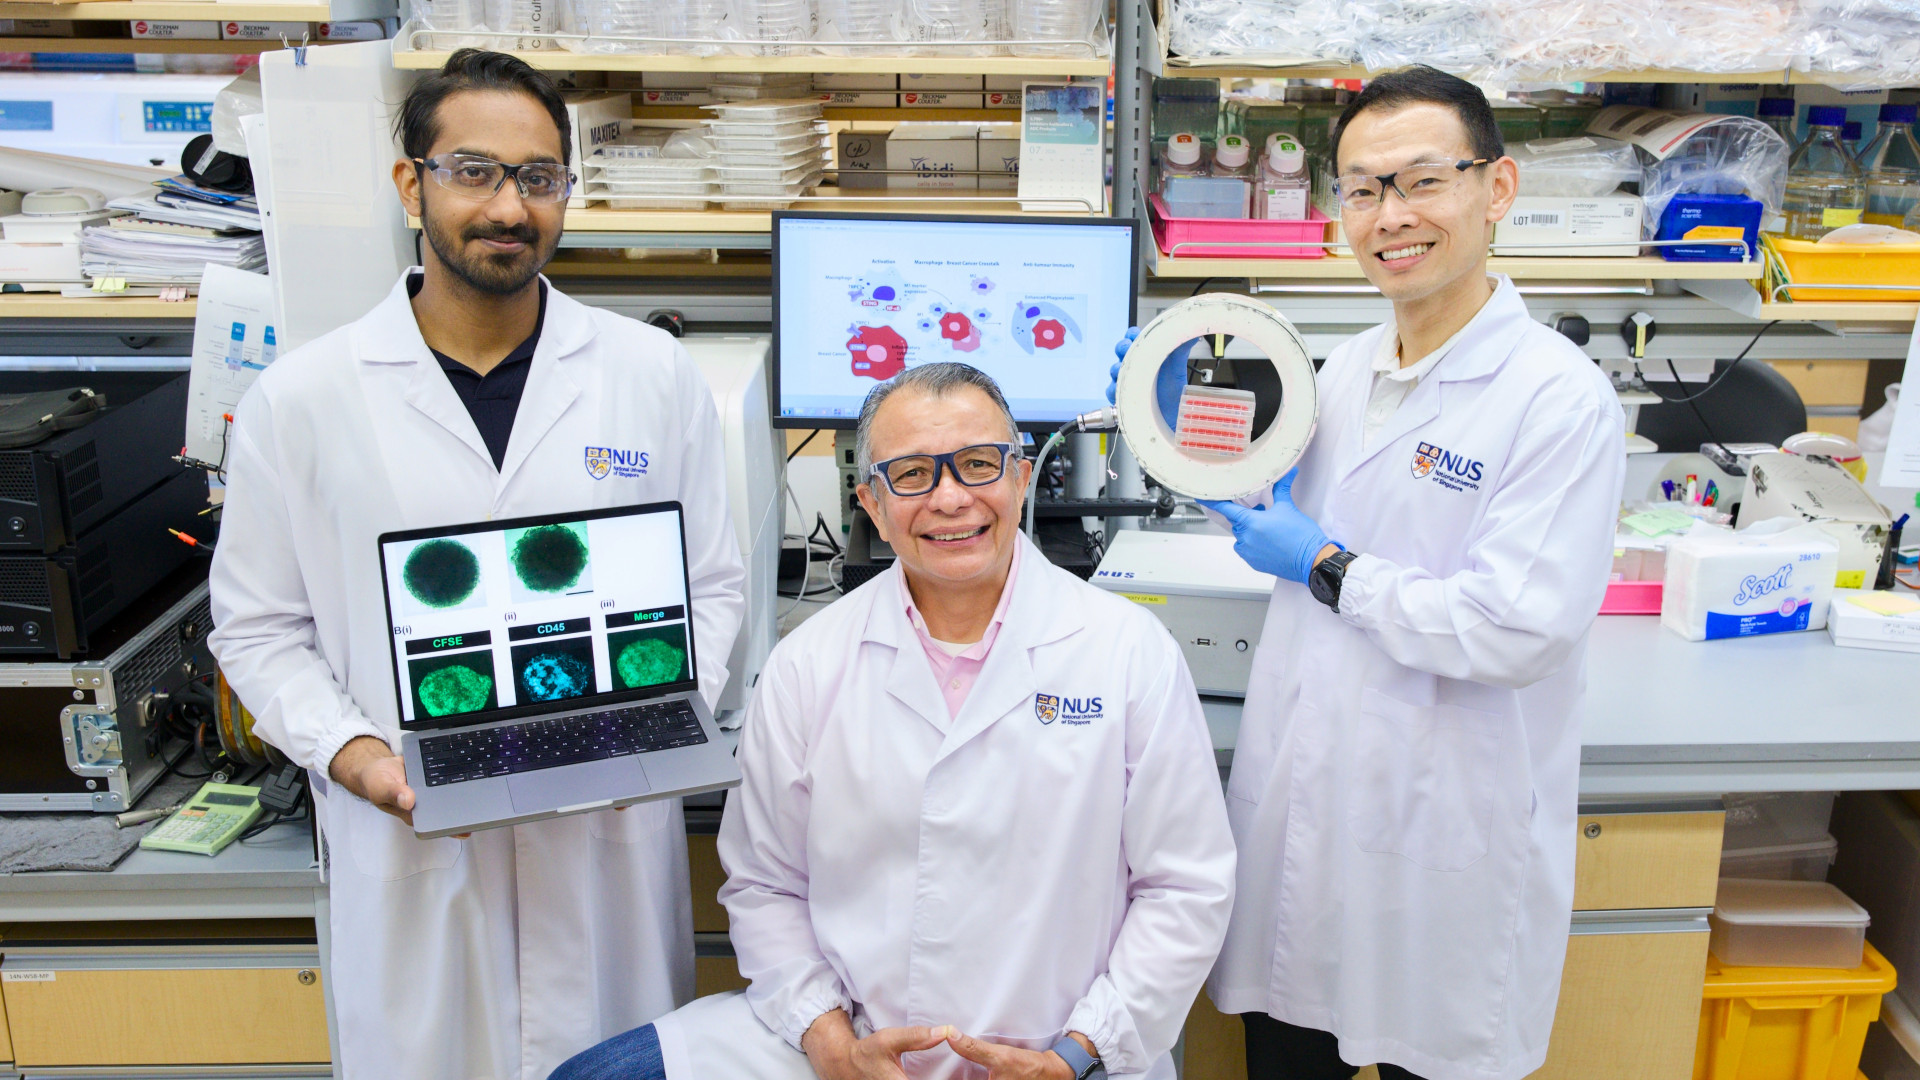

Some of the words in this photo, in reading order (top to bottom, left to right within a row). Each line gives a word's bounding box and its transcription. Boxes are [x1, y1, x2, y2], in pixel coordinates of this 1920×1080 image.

[531, 25, 541, 49] Cll
[590, 121, 621, 146] MAXITEX
[914, 161, 954, 178] ibidi
[1513, 216, 1529, 226] LOT
[613, 449, 649, 468] NUS
[630, 467, 648, 475] University
[1439, 450, 1484, 481] NUS
[1435, 469, 1455, 482] National
[1454, 477, 1480, 491] University
[1438, 479, 1463, 492] Singapore
[1799, 553, 1821, 561] 28610
[1097, 570, 1136, 579] NUS
[1733, 563, 1793, 606] Scott
[600, 598, 615, 610] (iii)
[504, 611, 517, 622] (ii)
[633, 610, 665, 622] Merge
[394, 625, 412, 635] B(i)
[537, 622, 566, 634] CD45
[432, 636, 463, 648] CFSE
[1062, 697, 1103, 714] NUS
